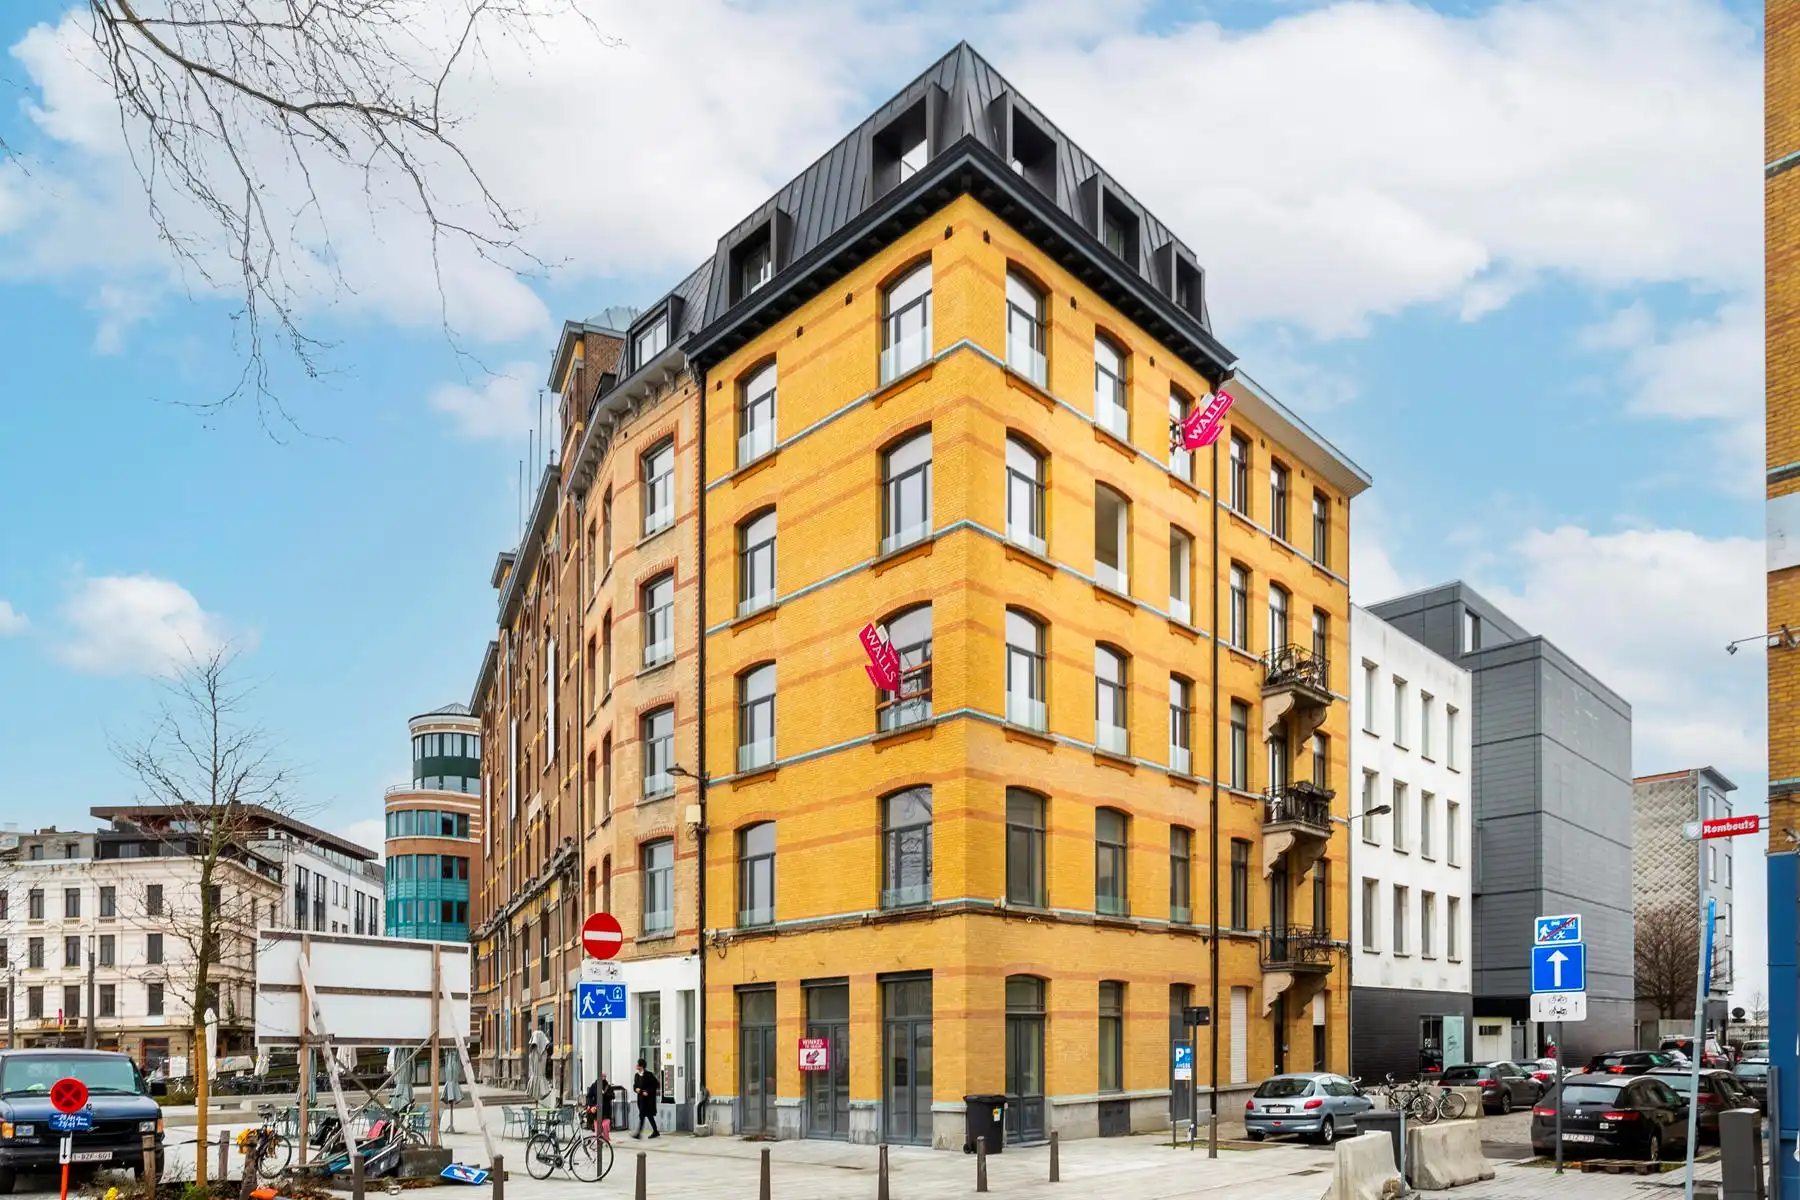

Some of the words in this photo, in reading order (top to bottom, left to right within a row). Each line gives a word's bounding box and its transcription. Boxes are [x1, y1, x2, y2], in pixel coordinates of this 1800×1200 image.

[1188, 393, 1227, 440] WALLS
[866, 627, 896, 683] WALLS
[1703, 819, 1756, 834] Rombouts
[1175, 1047, 1185, 1062] P
